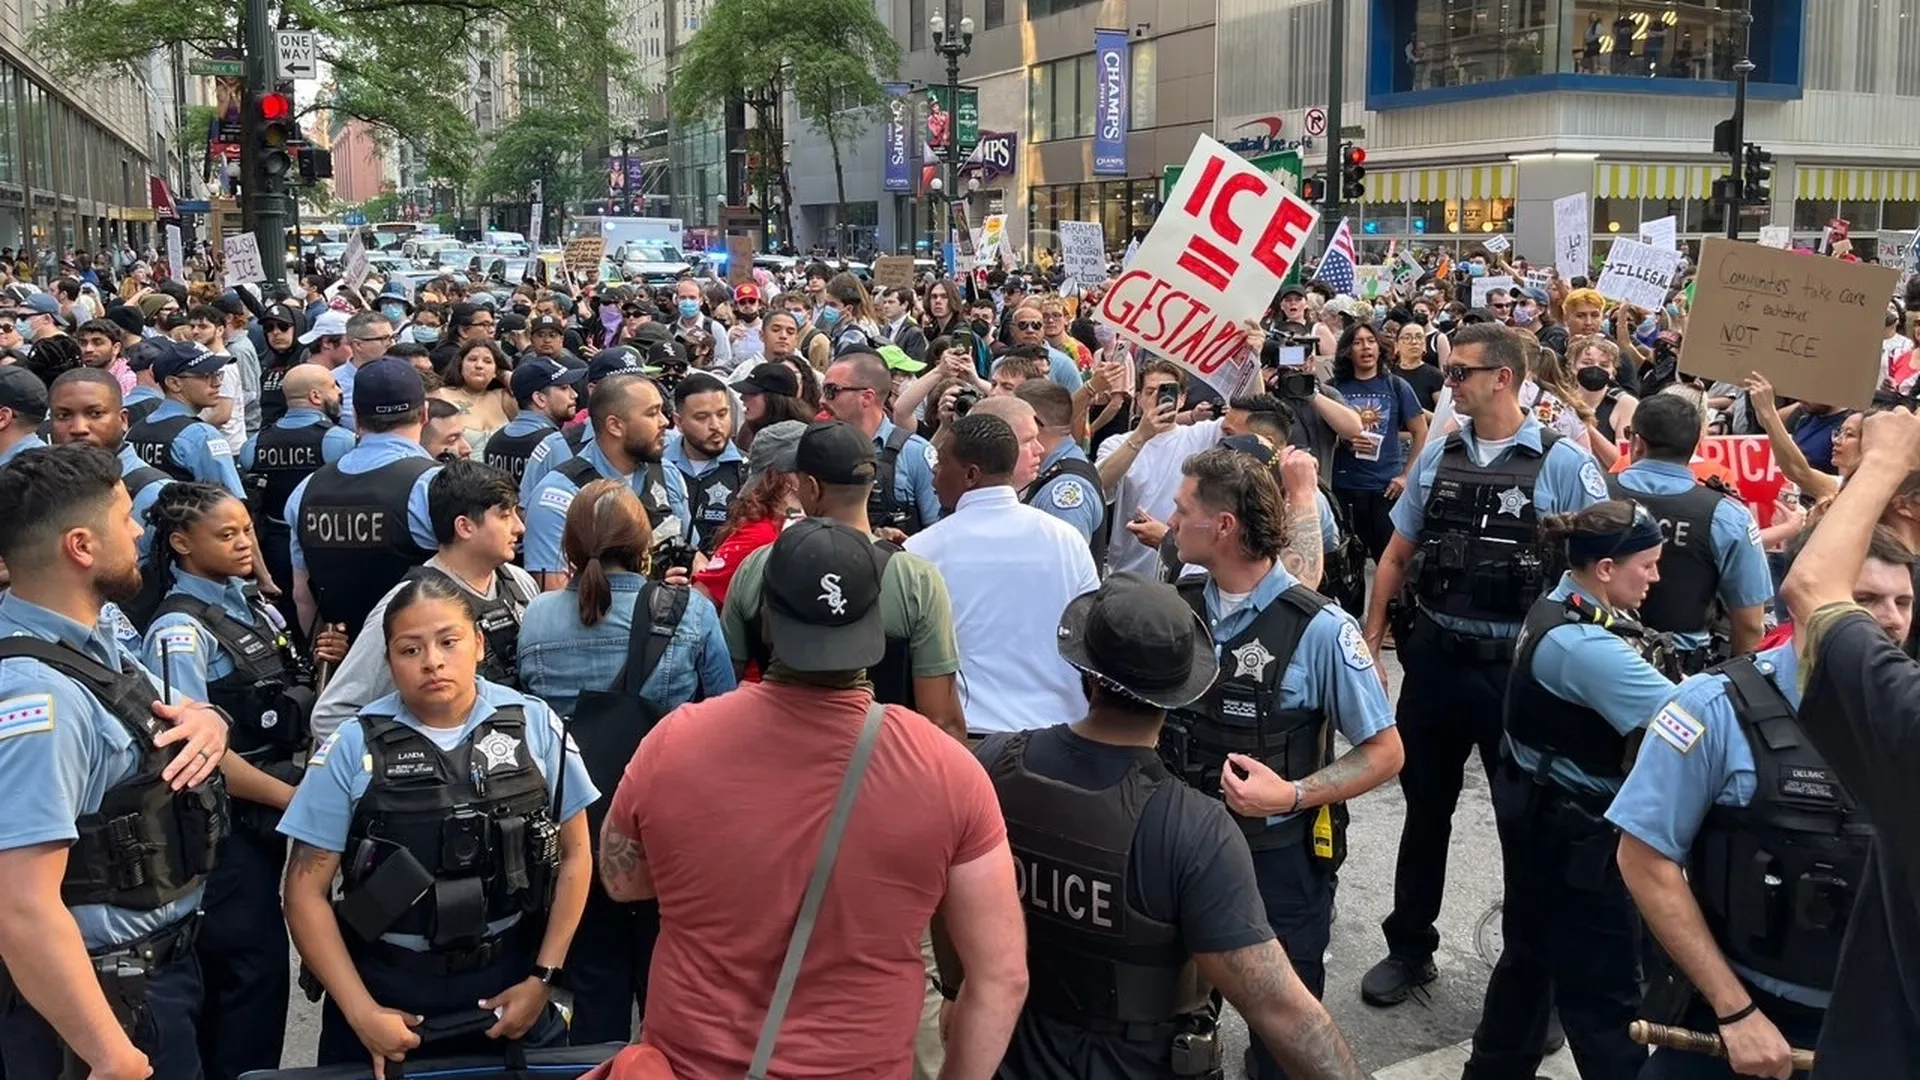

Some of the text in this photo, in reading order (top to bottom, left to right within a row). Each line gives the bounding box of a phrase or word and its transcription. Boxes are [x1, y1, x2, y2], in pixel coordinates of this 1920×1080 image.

[281, 35, 310, 47] ONE
[281, 48, 310, 60] WAY
[1103, 51, 1120, 140] CHAMPS
[890, 100, 906, 165] CHAMPS
[1184, 155, 1314, 279] ICE
[232, 259, 258, 280] ICE
[1176, 234, 1240, 293] =
[1614, 262, 1669, 290] ILLEGAL
[1738, 295, 1752, 313] of
[1102, 269, 1251, 375] GESTAPO
[1720, 321, 1822, 358] NOT ICE
[258, 447, 316, 465] POLICE
[488, 453, 529, 476] POLIC
[307, 512, 384, 542] POLICE
[398, 751, 425, 760] LANDA
[1014, 856, 1113, 927] OLICE
